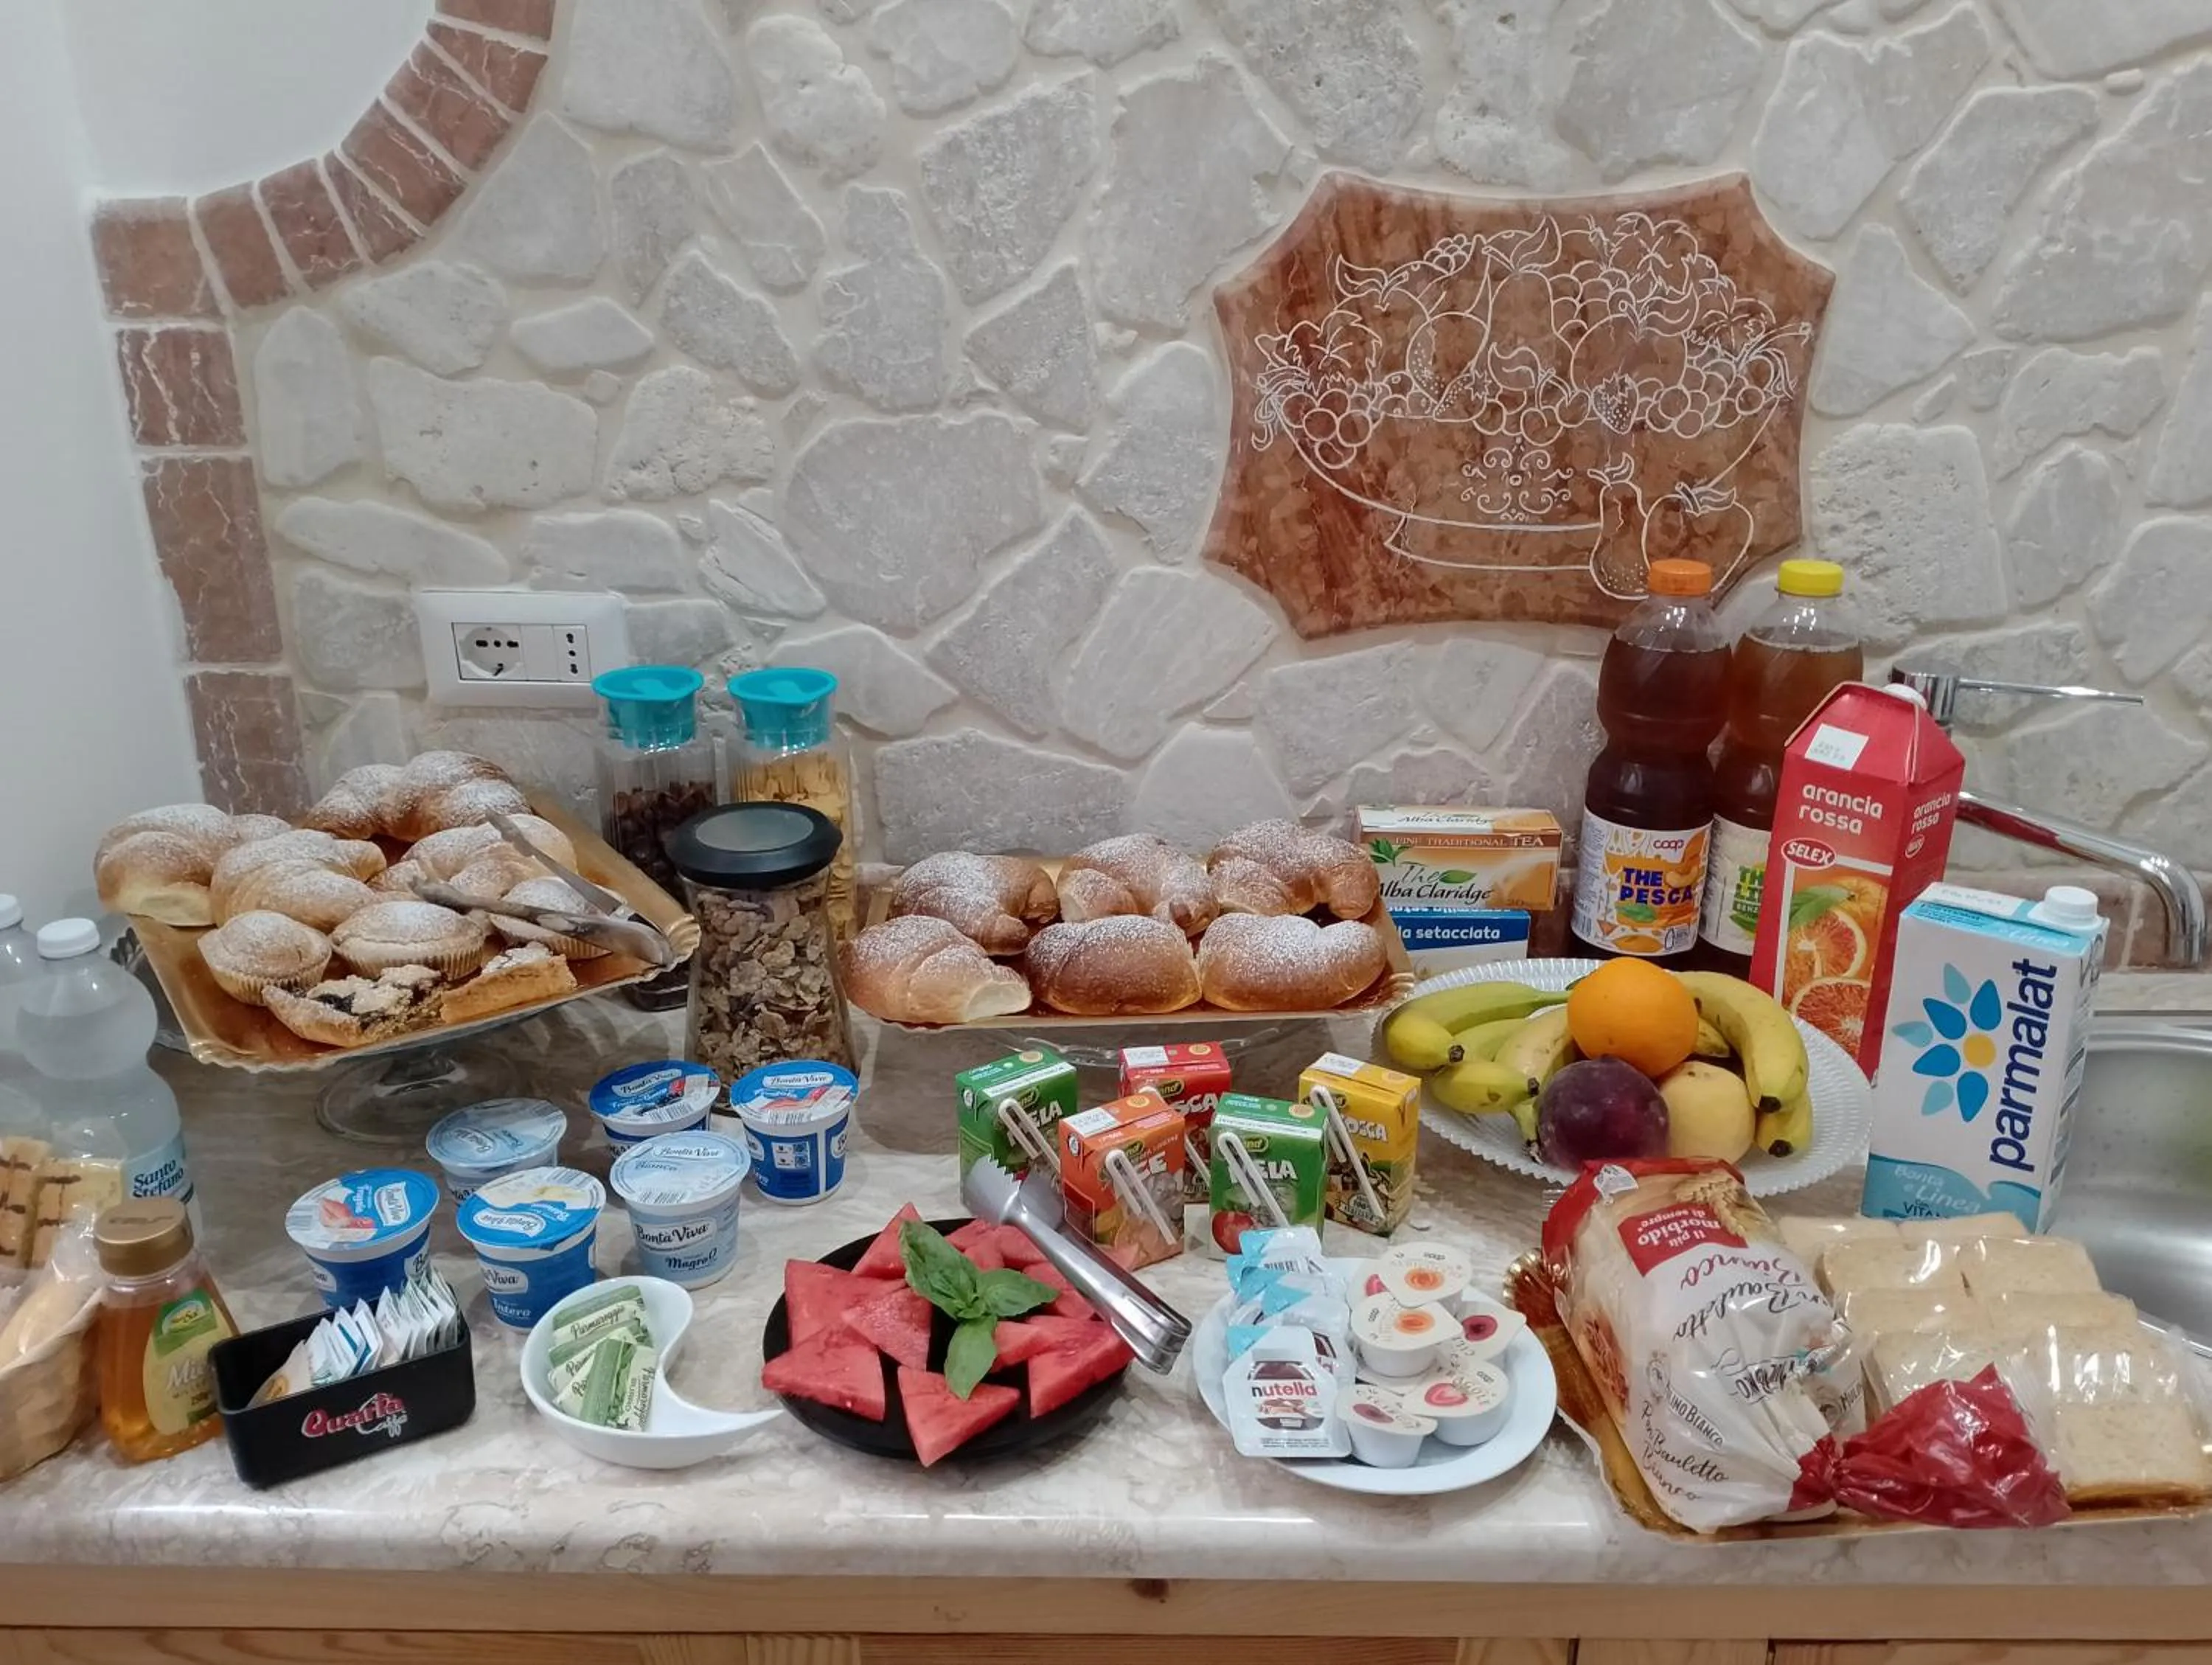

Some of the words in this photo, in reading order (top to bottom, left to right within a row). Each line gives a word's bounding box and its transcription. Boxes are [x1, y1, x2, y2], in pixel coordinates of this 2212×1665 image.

[1802, 784, 1883, 820] arancia
[1798, 805, 1863, 835] rossa
[1427, 838, 1506, 847] TRADITIONAL
[1512, 836, 1545, 847] TEA
[1787, 841, 1833, 865] SELEX
[1623, 867, 1664, 886] THE
[1379, 882, 1413, 897] Alba
[1416, 883, 1495, 905] Claridge
[1620, 886, 1694, 906] PESCA
[1416, 925, 1501, 939] setacciata
[1989, 956, 2058, 1172] parmalat
[133, 1159, 177, 1188] Santo
[1916, 1185, 1982, 1214] Linea
[1637, 1217, 1721, 1246] morbido
[1640, 1209, 1689, 1230] sempre
[1669, 1229, 1691, 1248] più
[1251, 1381, 1318, 1397] nutella
[1685, 1405, 1724, 1446] BIANCO
[1653, 1429, 1730, 1483] Bauletto
